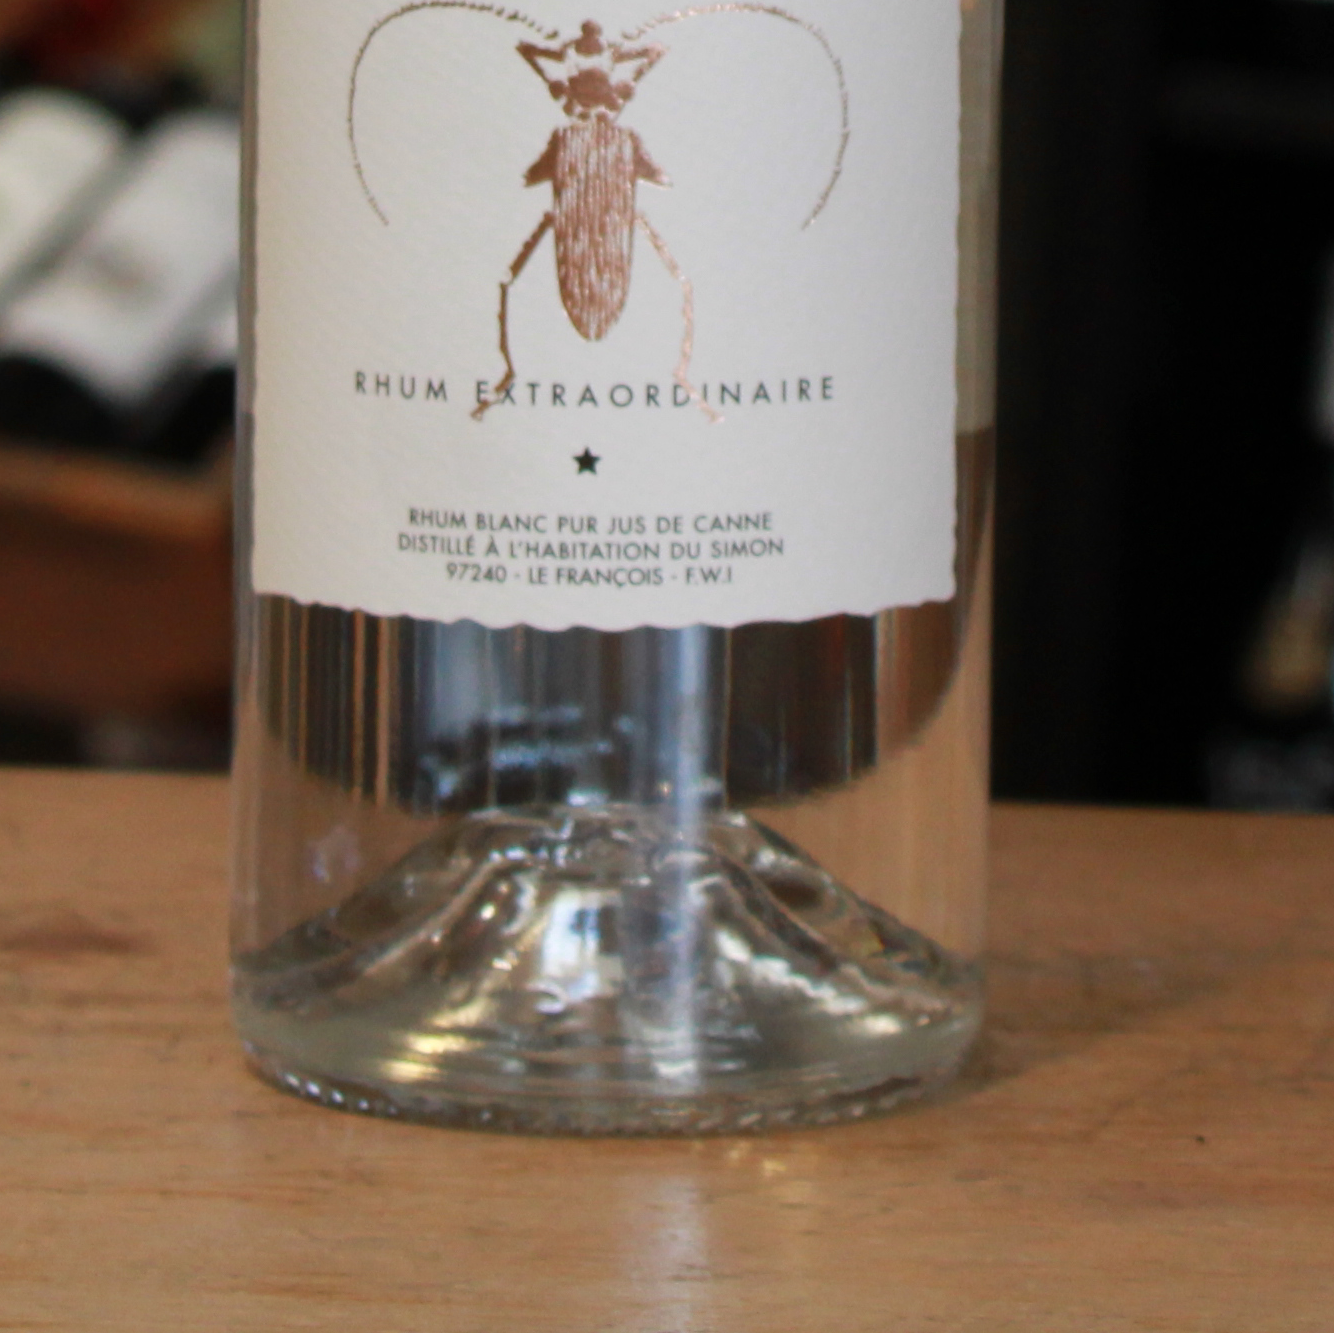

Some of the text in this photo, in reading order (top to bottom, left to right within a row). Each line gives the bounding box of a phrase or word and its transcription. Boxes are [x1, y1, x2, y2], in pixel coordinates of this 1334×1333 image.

[354, 370, 835, 409] RHUM EXTRAORDINAIRE
[408, 508, 773, 535] RHUM BLANC PUR JUS DE CANNE
[397, 532, 785, 561] DISTILLÉ À L'HABITATION DU SIMON
[446, 562, 508, 584] 97240
[527, 566, 548, 585] LE
[555, 566, 664, 589] FRANÇOIS
